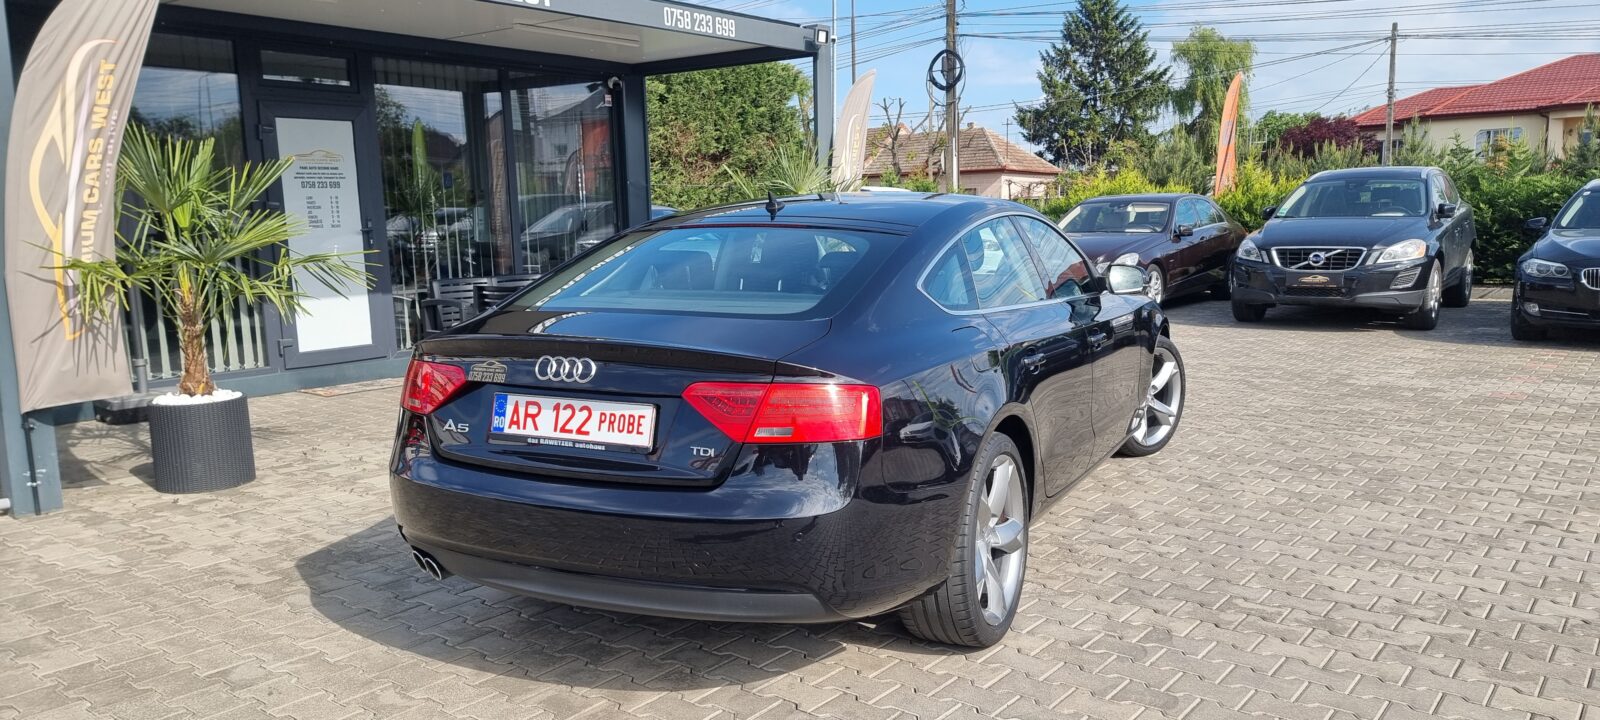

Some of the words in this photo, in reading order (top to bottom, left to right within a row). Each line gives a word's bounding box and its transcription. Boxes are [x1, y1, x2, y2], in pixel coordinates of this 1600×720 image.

[664, 7, 691, 29] 0758
[694, 13, 713, 33] 233
[715, 17, 736, 37] 699
[91, 59, 117, 130] WEST
[83, 137, 104, 204] CARS
[301, 181, 316, 189] 0758
[317, 181, 328, 189] 233
[329, 181, 341, 189] 699
[443, 418, 469, 433] A5
[494, 415, 505, 428] RO
[508, 400, 542, 431] AR
[552, 402, 593, 436] 122
[597, 412, 646, 435] PROBE
[690, 446, 715, 458] TDI
